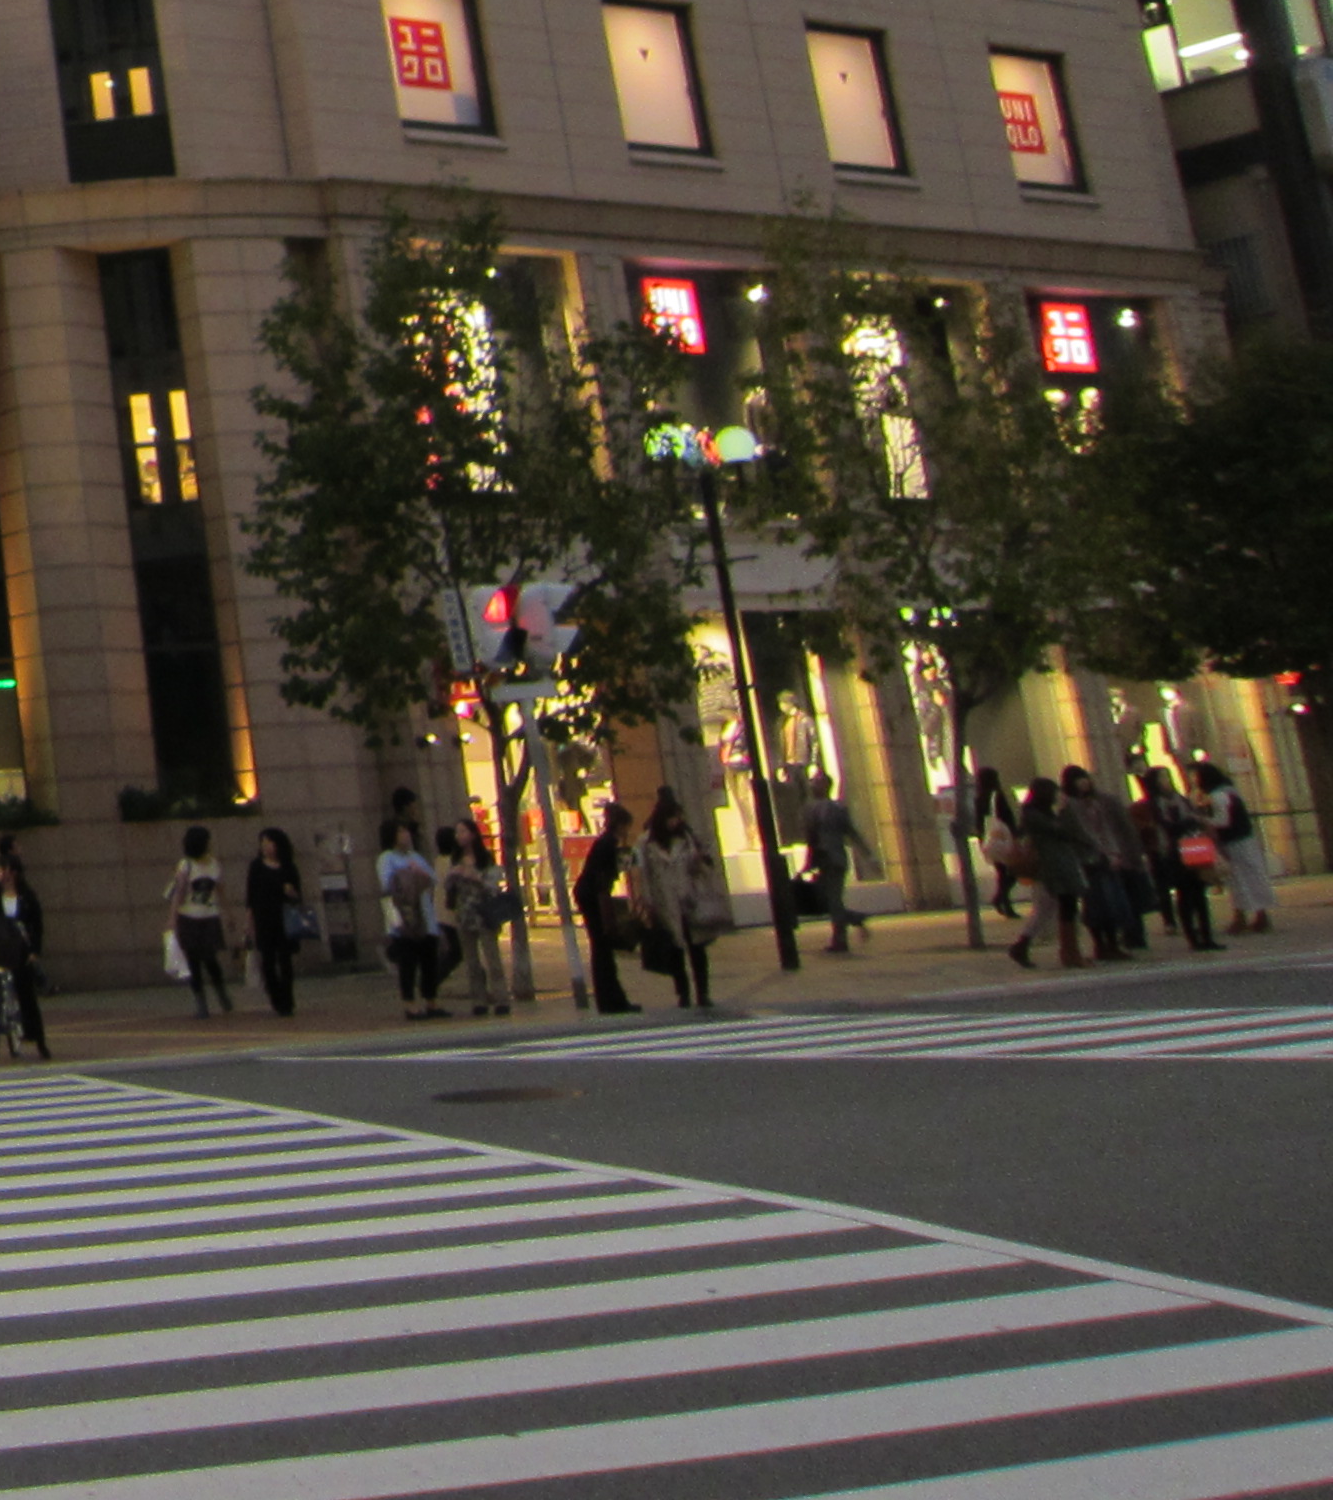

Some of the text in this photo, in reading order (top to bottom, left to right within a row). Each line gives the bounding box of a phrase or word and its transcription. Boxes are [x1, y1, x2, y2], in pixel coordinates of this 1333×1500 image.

[398, 25, 440, 53] ユニ
[402, 54, 445, 83] クロ
[998, 99, 1033, 121] UNI
[1006, 123, 1040, 148] QLO
[1046, 310, 1085, 337] ユニ
[1052, 338, 1090, 365] クロ
